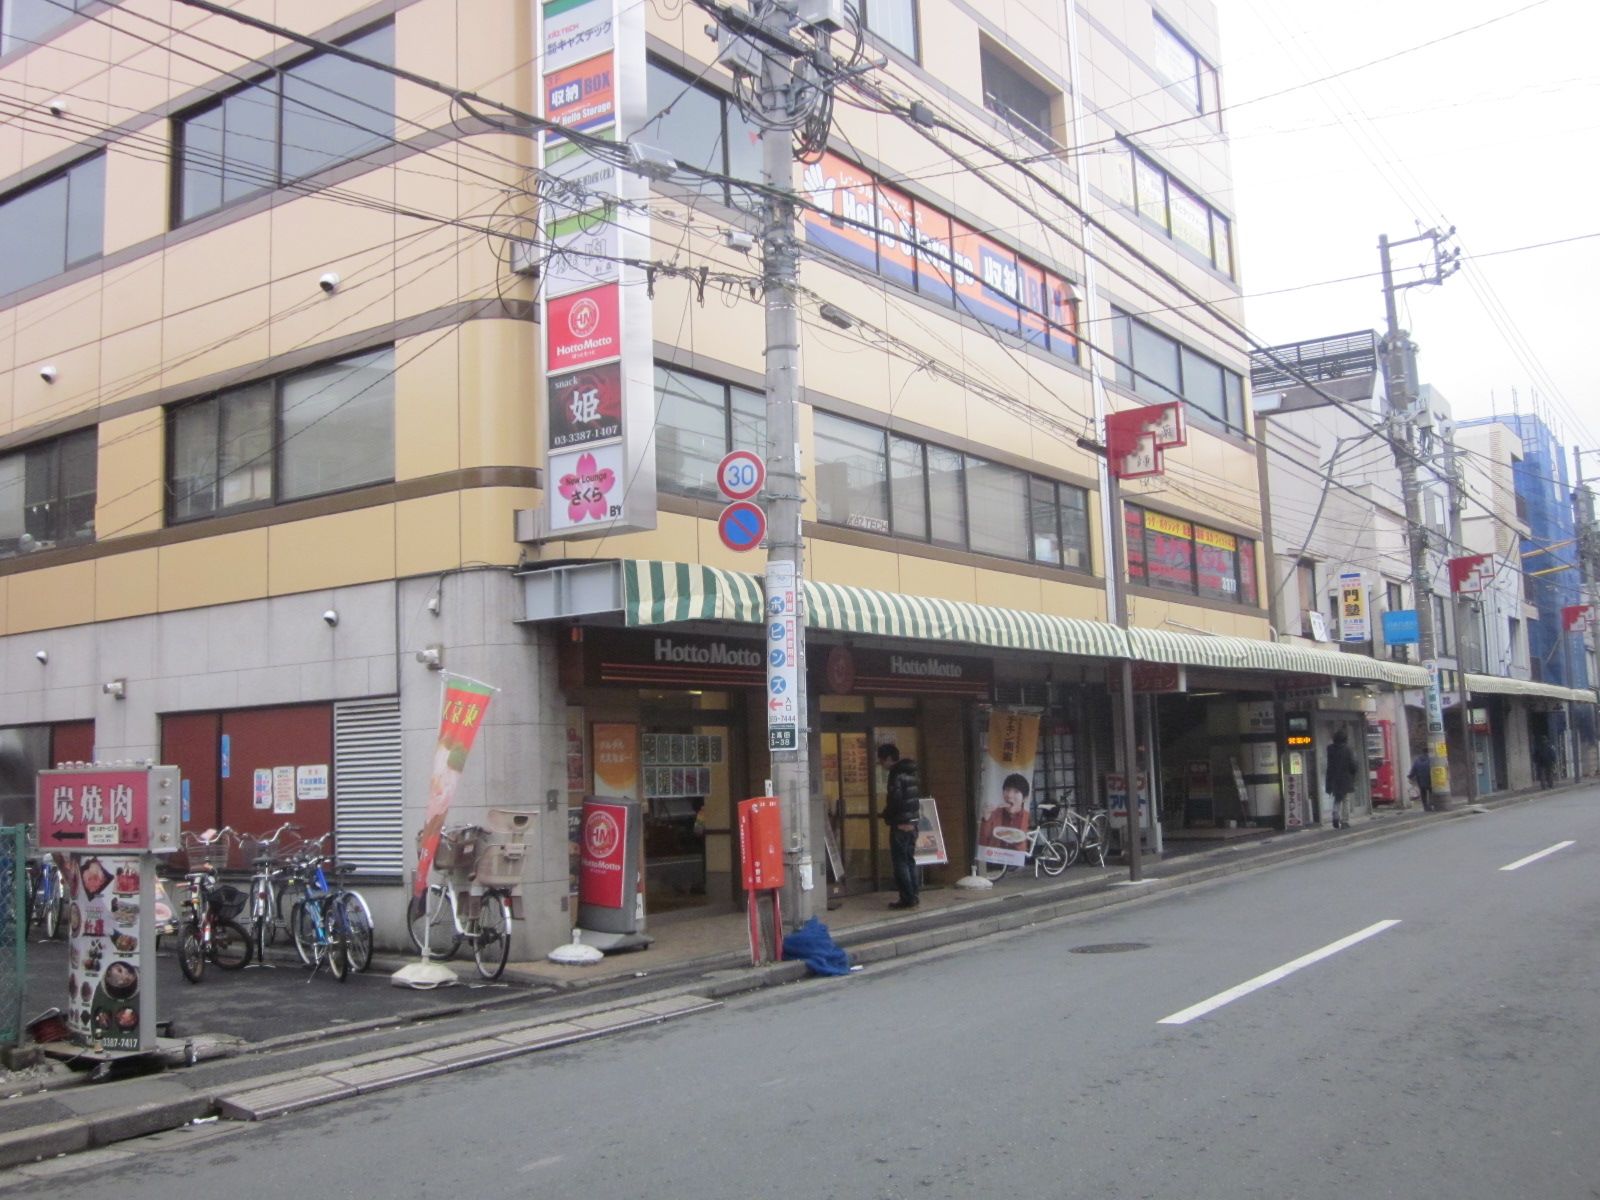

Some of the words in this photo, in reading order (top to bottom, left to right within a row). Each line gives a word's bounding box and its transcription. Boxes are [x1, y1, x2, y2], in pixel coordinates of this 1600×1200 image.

[551, 83, 579, 107] 収納
[585, 71, 610, 95] BOX
[562, 111, 581, 126] Hello
[582, 102, 611, 118] Storage
[841, 188, 896, 248] Hello
[899, 219, 976, 286] Storage
[556, 337, 612, 357] HottoMotto
[555, 376, 578, 389] snack
[569, 388, 601, 424] 姫
[565, 478, 580, 486] New
[581, 473, 607, 484] Lounge
[728, 464, 754, 487] 30
[572, 486, 603, 506] さくら
[654, 638, 761, 667] HottoMotto
[890, 655, 962, 678] HottoMotto
[785, 697, 791, 711] 入口
[770, 731, 791, 739] 上高田
